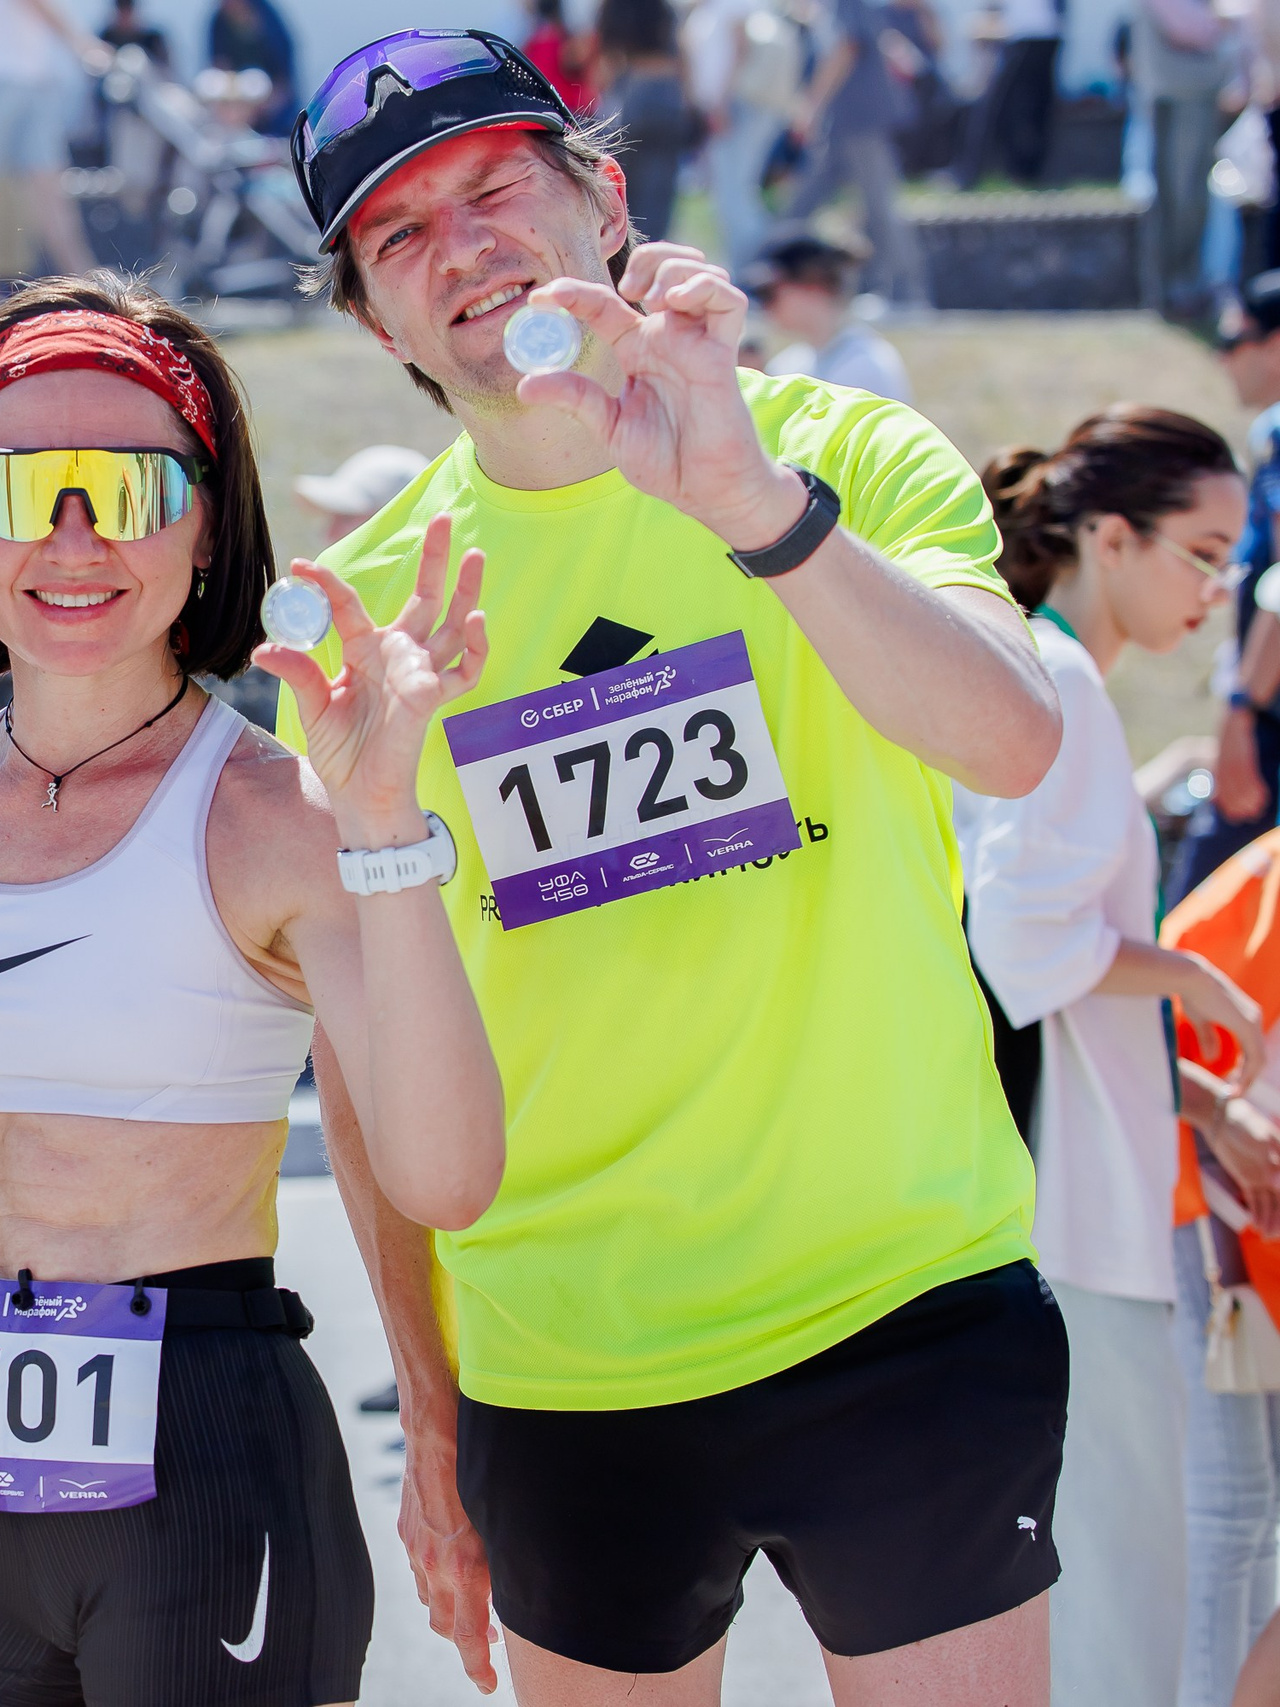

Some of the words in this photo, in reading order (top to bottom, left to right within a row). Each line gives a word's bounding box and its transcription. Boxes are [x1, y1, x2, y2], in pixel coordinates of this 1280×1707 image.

[608, 671, 655, 694] зелёный
[605, 684, 653, 705] марафон
[542, 698, 584, 720] СБЕР
[498, 708, 749, 853] 1723
[707, 840, 754, 858] VERRA
[538, 870, 586, 892] УФА
[59, 1490, 108, 1499] VERRA
